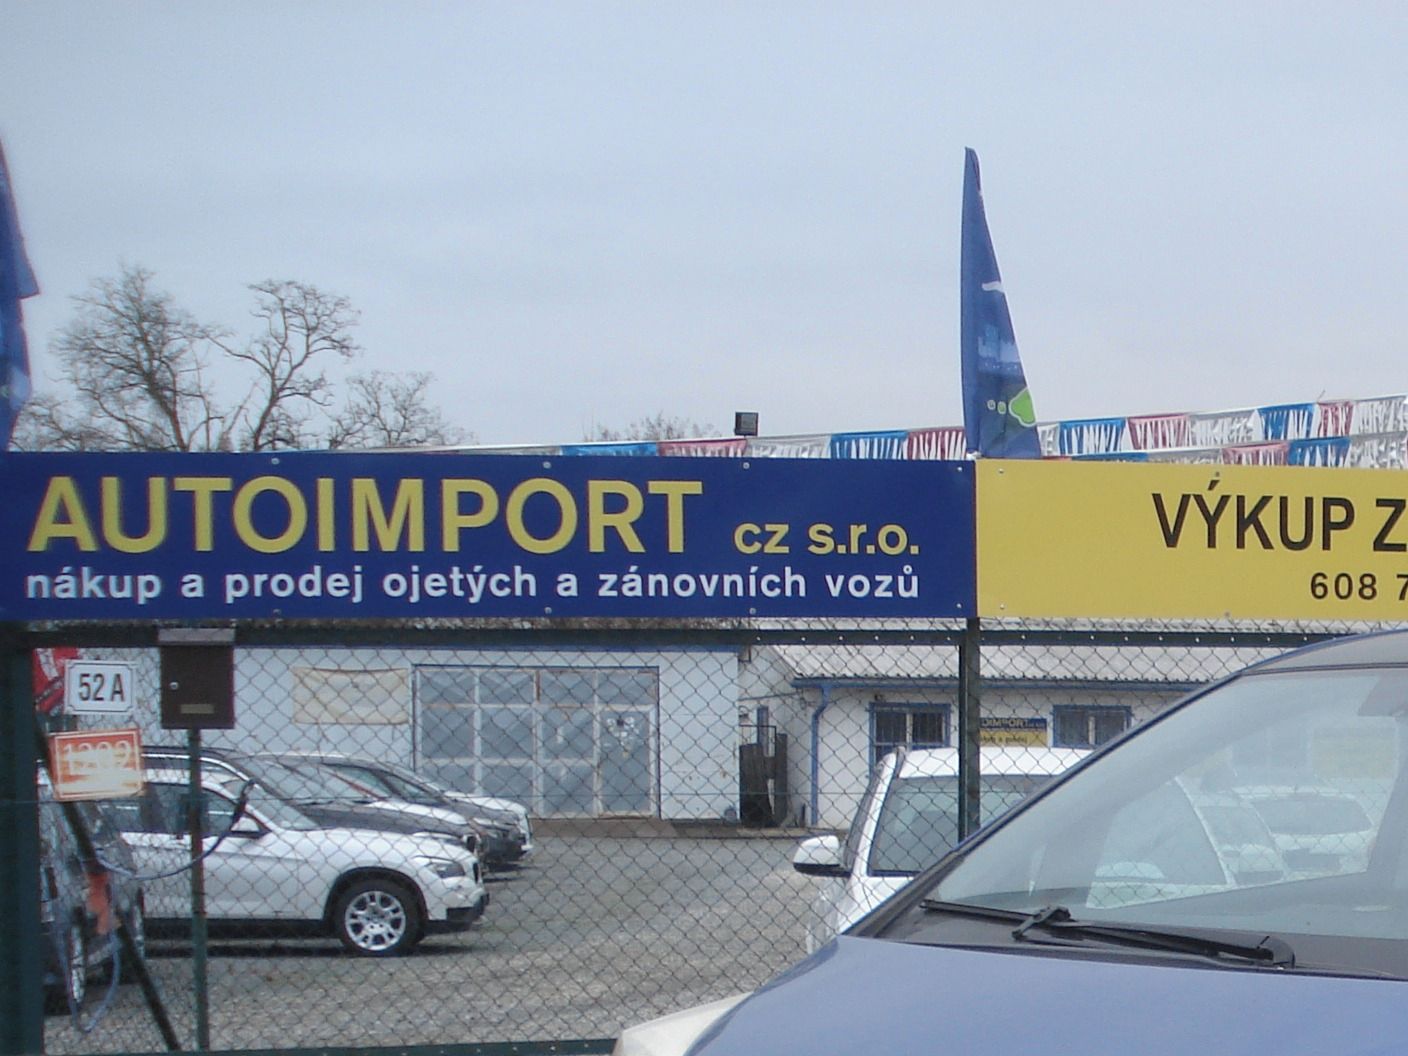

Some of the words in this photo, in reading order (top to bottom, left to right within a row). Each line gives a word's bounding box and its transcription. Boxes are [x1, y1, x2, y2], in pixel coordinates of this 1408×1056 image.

[26, 475, 703, 555] AUTOIMPORT
[734, 522, 790, 554] cz
[807, 523, 920, 555] s.r.o.
[1151, 479, 1357, 552] VÝKUP
[26, 566, 162, 604] nákup
[181, 571, 206, 599] a
[225, 565, 364, 604] prodej
[383, 565, 537, 604] ojetých
[556, 571, 579, 598] a
[598, 565, 807, 599] zánovních
[826, 565, 920, 599] vozů
[1310, 572, 1378, 601] 608
[78, 673, 105, 702] 52
[110, 673, 126, 702] A
